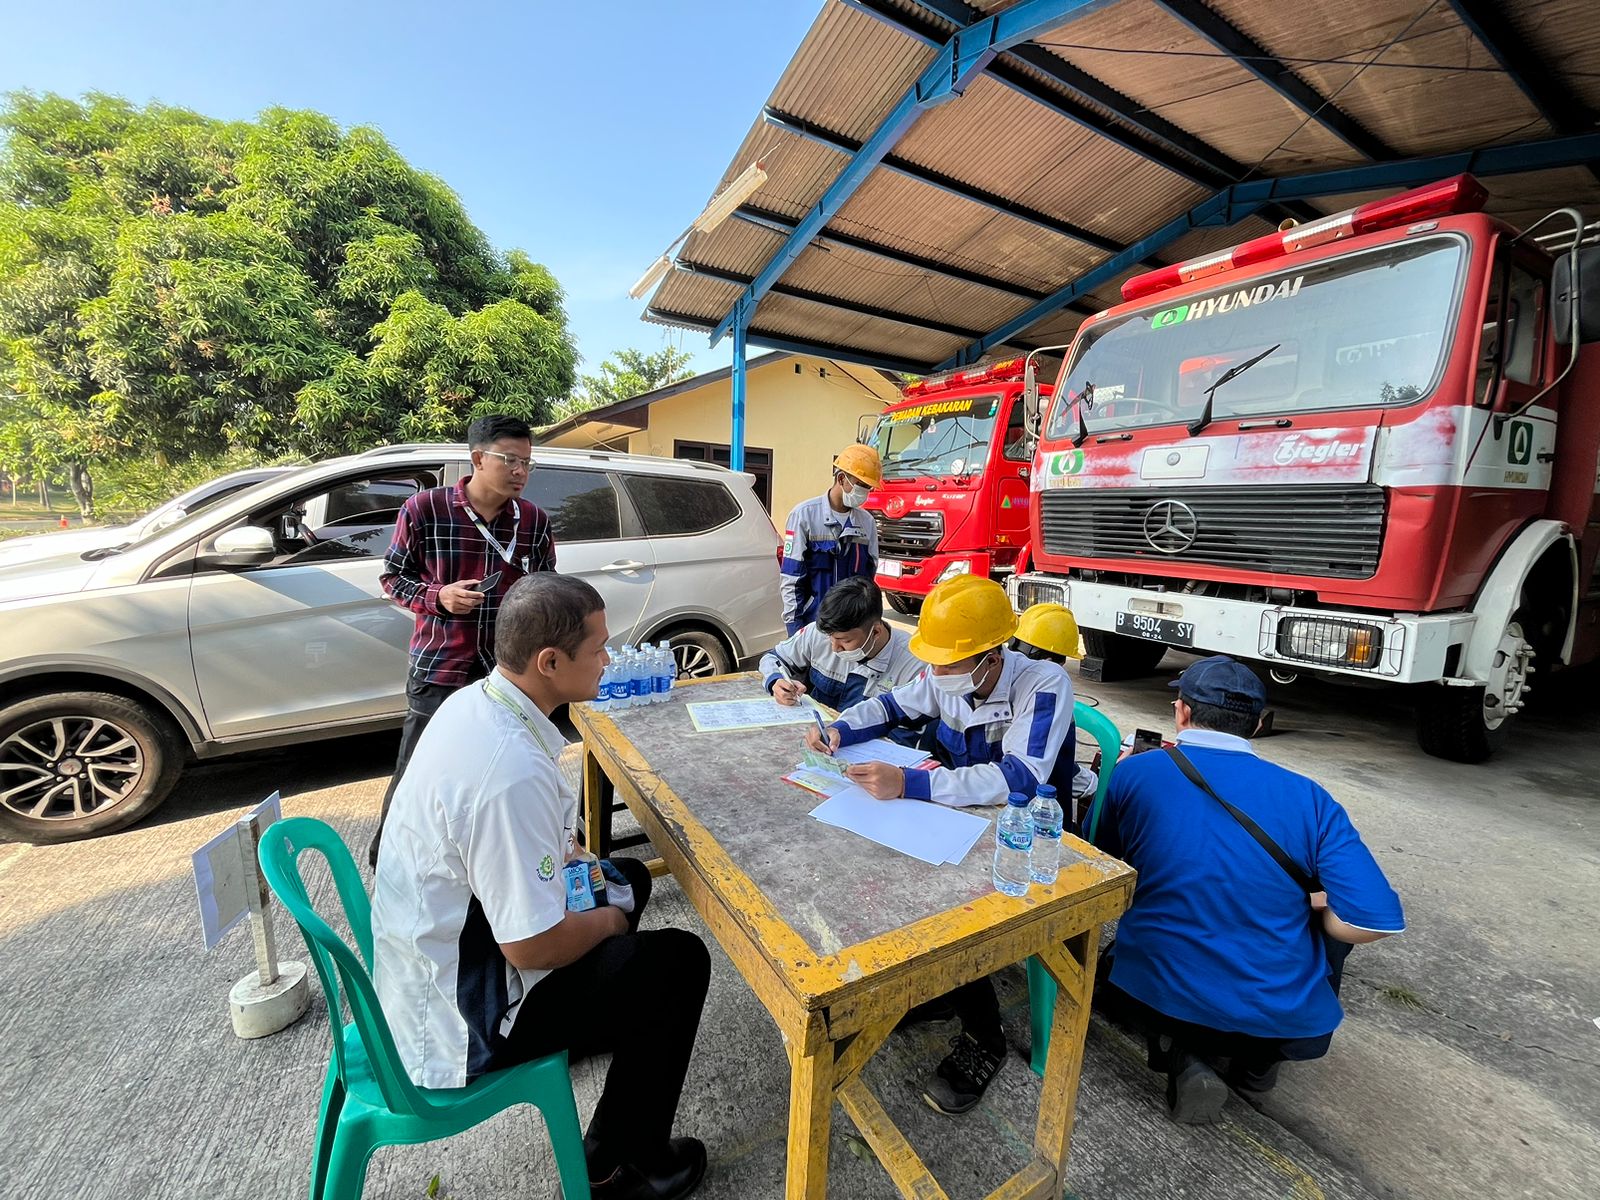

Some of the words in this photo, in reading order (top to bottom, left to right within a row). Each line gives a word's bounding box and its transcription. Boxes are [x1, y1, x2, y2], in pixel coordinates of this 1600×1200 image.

[1185, 275, 1304, 321] HYUNDAI
[921, 399, 973, 416] KEBAKARAN
[1273, 438, 1366, 466] Ziegler
[1117, 612, 1125, 626] B
[1133, 615, 1162, 634] 9504
[1177, 623, 1193, 639] SY
